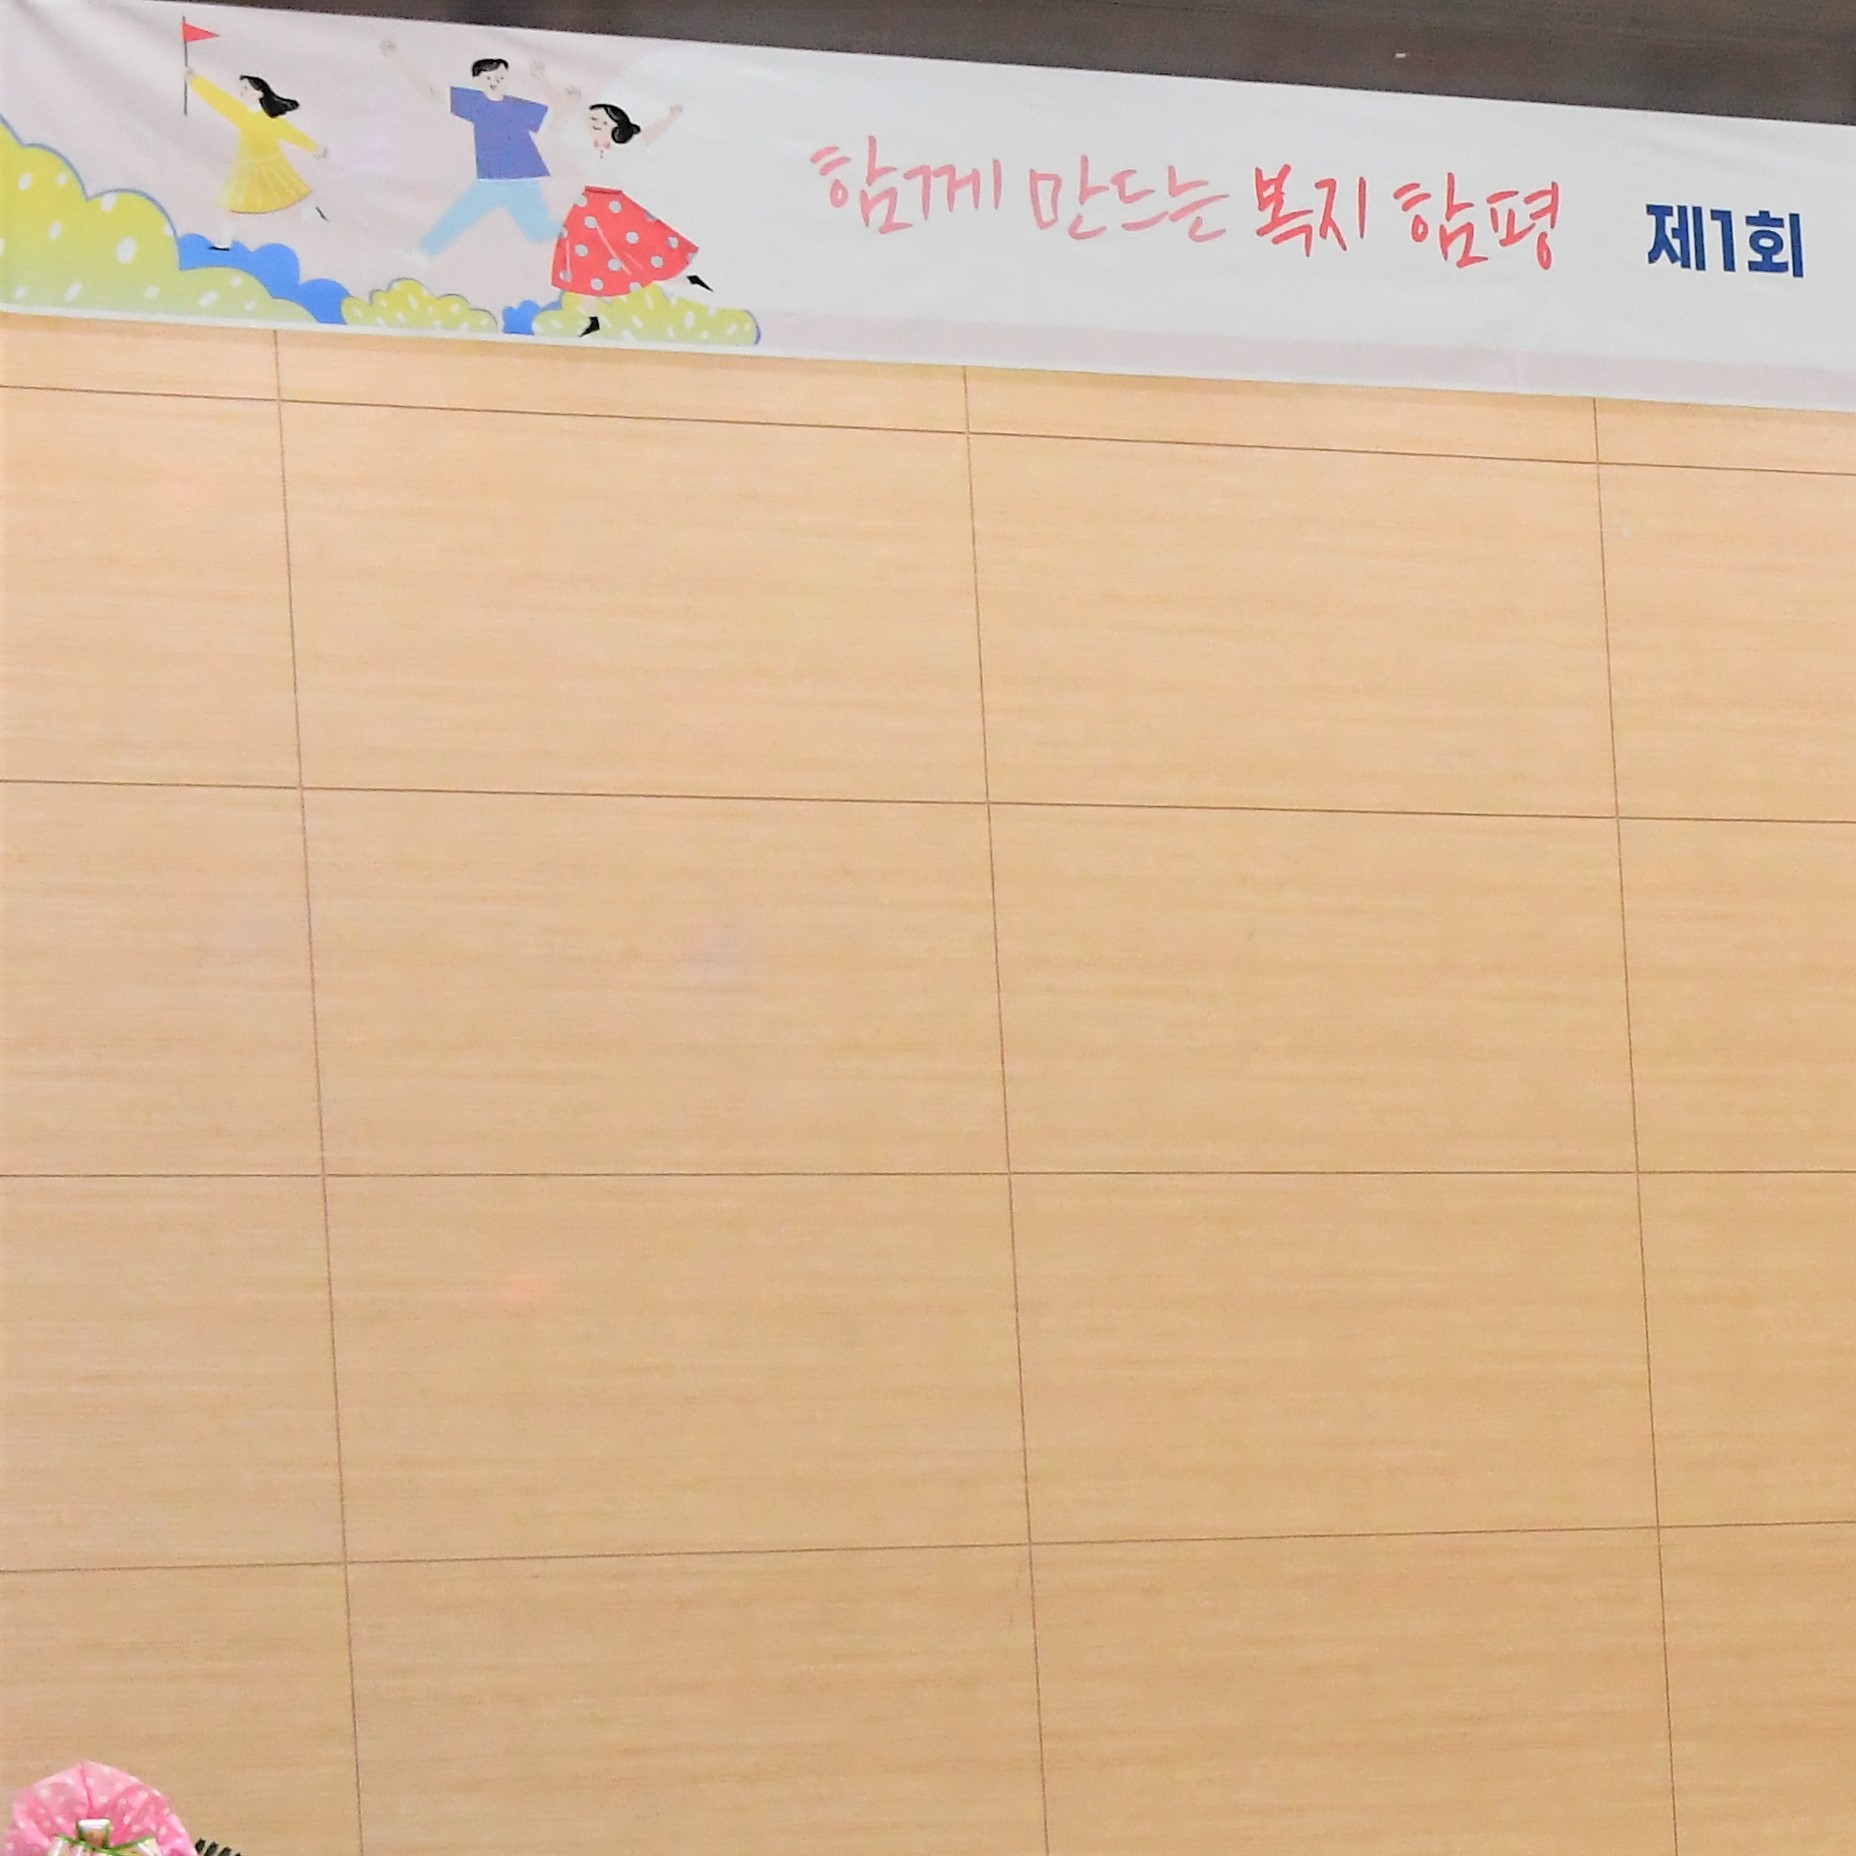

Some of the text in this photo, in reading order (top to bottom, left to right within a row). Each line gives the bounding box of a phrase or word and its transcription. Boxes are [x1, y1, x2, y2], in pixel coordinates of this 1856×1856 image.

[811, 136, 1560, 270] 함께 만드는 복지 함평
[1646, 204, 1803, 278] 제1회
